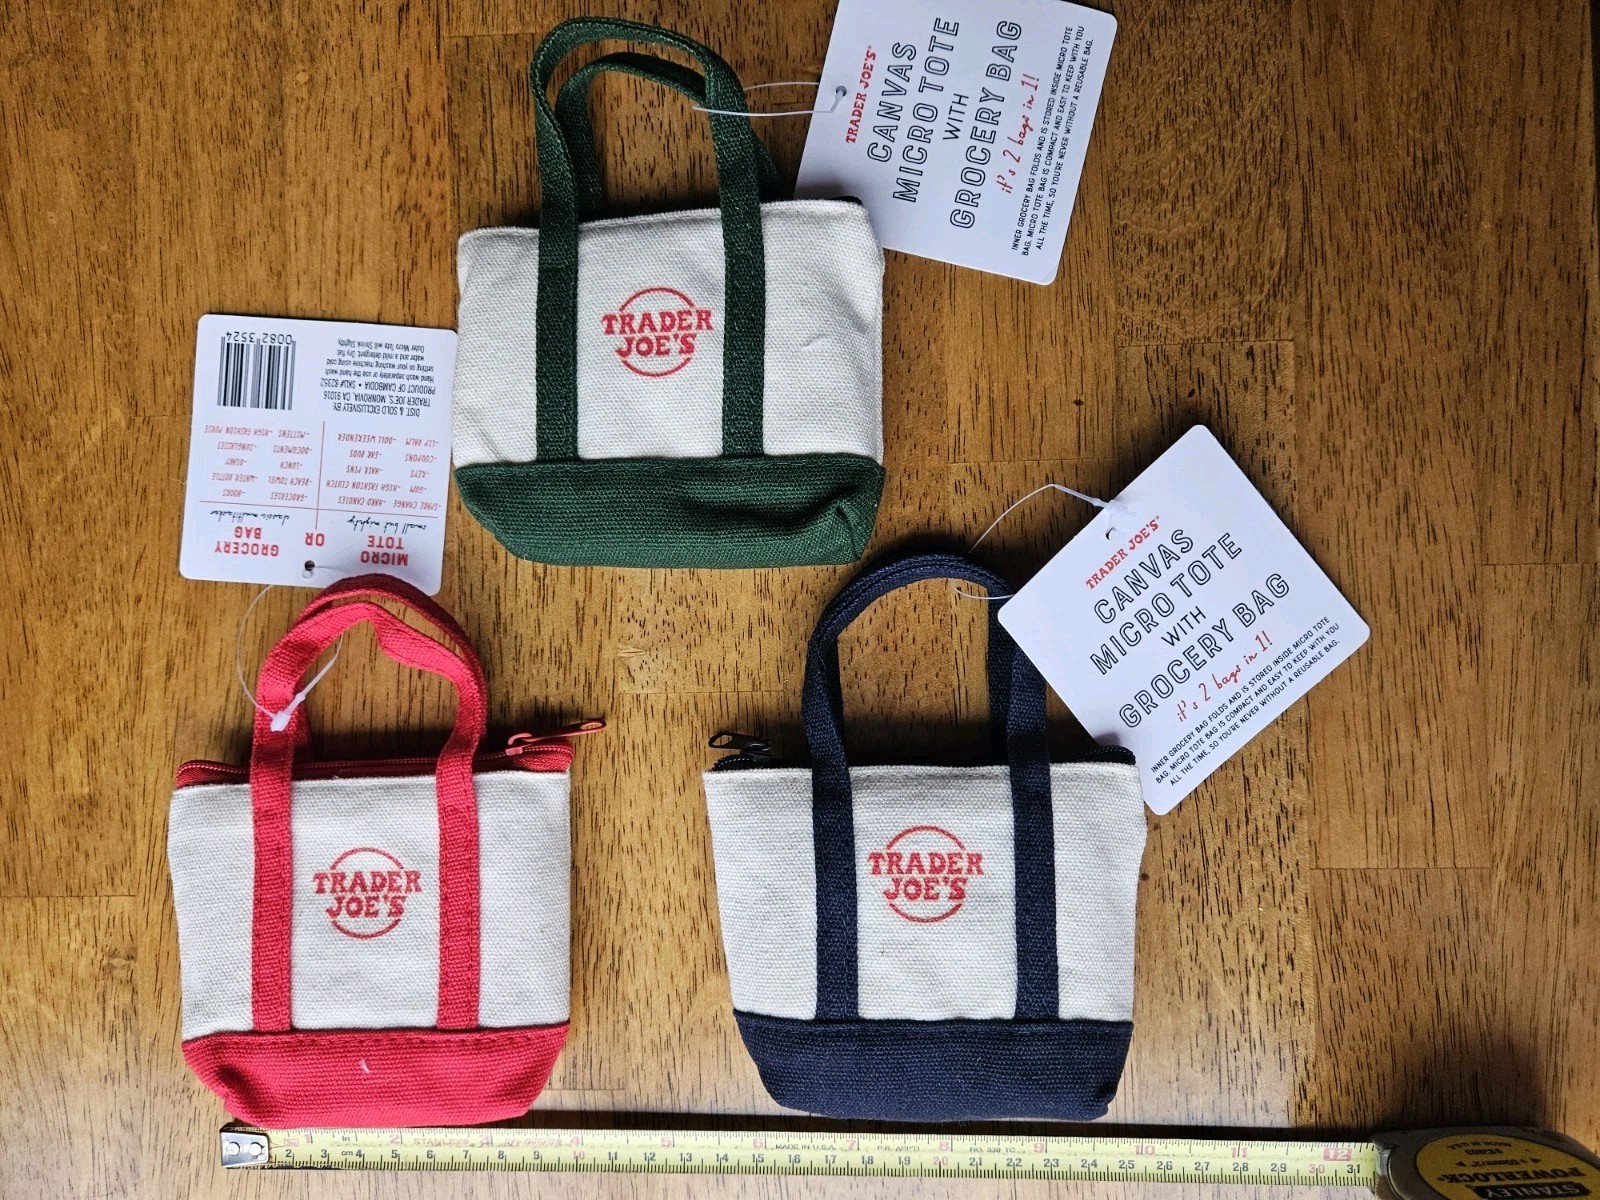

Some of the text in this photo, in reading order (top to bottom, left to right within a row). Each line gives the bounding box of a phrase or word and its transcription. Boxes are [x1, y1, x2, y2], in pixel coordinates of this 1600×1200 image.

[1082, 39, 1094, 56] BAG.
[1073, 57, 1089, 94] REUSABLE
[866, 42, 917, 163] CANVAS
[892, 17, 960, 203] MICRO TOTE
[845, 92, 867, 144] TRADER
[942, 93, 970, 140] WITH
[949, 20, 1022, 229] GROCERY BAG
[1063, 101, 1078, 135] WITHOUT
[996, 73, 1040, 194] it's 2 bags in 1!
[1011, 26, 1073, 251] INNER GROCERY BAG FOLDS AND IS STORED INSIDE MICRO TOTE
[1021, 25, 1085, 256] BAG. MICRO TOTE BAG IS COMPACT AND EASY TO KEEP WITH YOU
[1057, 136, 1069, 160] NEVER
[1051, 161, 1064, 186] YOU'RE
[1048, 187, 1057, 198] SO
[1042, 200, 1055, 219] TIME,
[1038, 220, 1049, 234] THE
[1035, 237, 1045, 251] ALL
[600, 309, 714, 335] TRADER
[224, 331, 293, 346] 0082 3524
[615, 333, 697, 358] JOE'S
[234, 525, 262, 540] BAG
[346, 515, 427, 535] small but mighty
[214, 540, 279, 557] GROCERY
[304, 532, 325, 547] OR
[367, 535, 404, 550] TOTE
[360, 550, 409, 567] MICRO
[1085, 548, 1129, 590] TRADER
[1093, 529, 1194, 625] CANVAS
[1089, 532, 1243, 676] MICRO TOTE
[1160, 605, 1207, 647] WITH
[1118, 573, 1290, 729] GROCERY BAG
[1177, 630, 1273, 723] it's 2 bags in 1!
[1150, 616, 1330, 774] INNER GROCERY BAG FOLDS AND IS STORED INSIDE MICRO TOTE
[1155, 622, 1340, 784] BAG. MICRO TOTE BAG IS COMPACT AND EASY TO KEEP WITH YOU
[1169, 639, 1338, 786] ALL THE TIME, SO YOU'RE NEVER WITHOUT A REUSABLE BAG.
[867, 852, 985, 875] TRADER
[312, 870, 423, 894] TRADER
[883, 876, 968, 901] JOE'S
[325, 894, 407, 918] JOE'S
[644, 1152, 1211, 1171] 12 13 14 15 16 17 18 19 23 24 25 26 27
[1442, 1167, 1587, 1184] POWERLOCK
[1485, 1183, 1580, 1200] STANLEY
